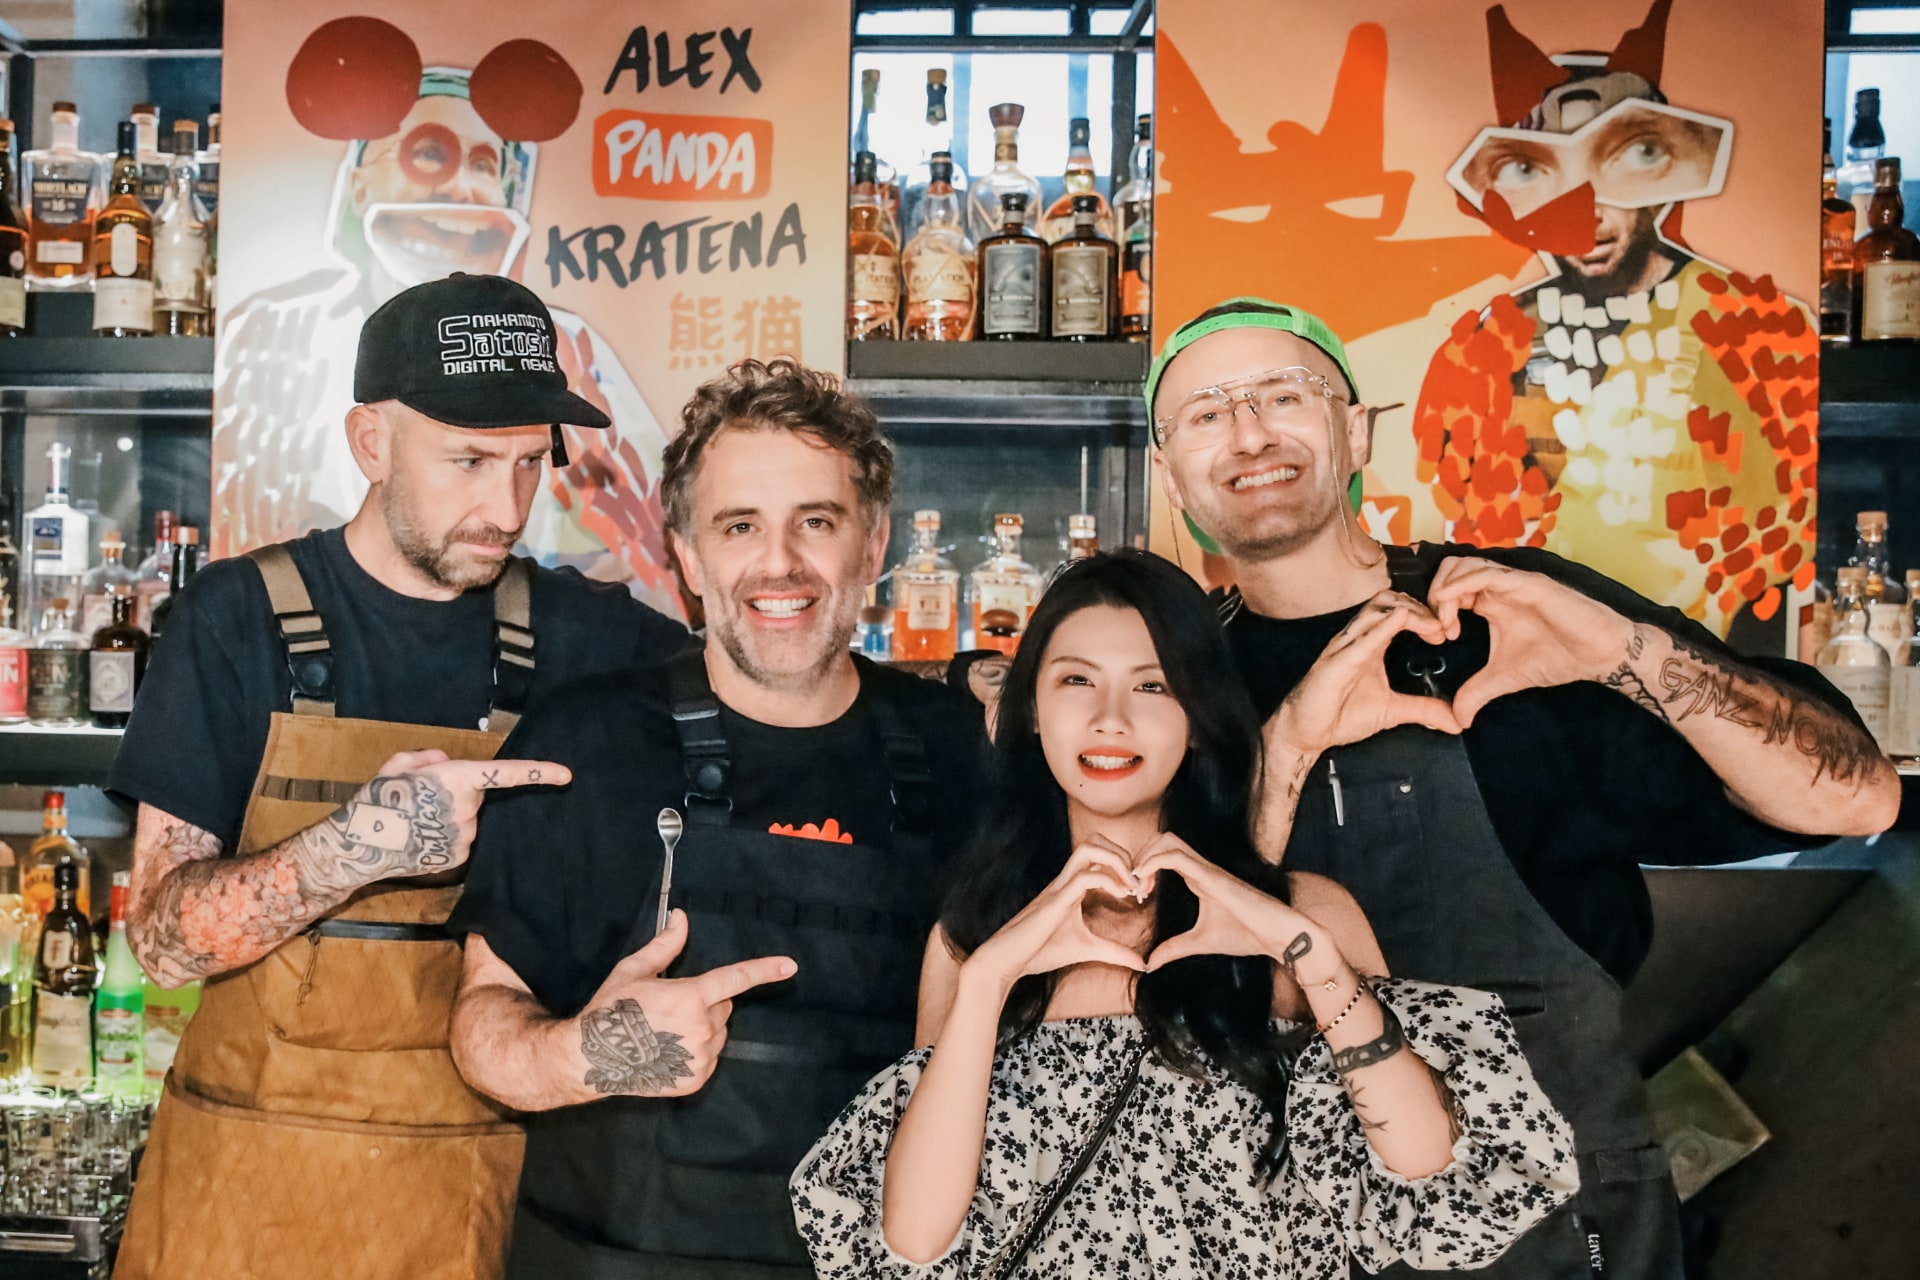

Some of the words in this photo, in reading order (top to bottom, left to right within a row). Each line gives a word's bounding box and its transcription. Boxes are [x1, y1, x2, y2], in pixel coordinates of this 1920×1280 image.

[604, 25, 762, 95] ALEX
[605, 120, 757, 195] PANDA
[545, 202, 807, 289] KRATENA
[443, 359, 515, 376] DIGITAL
[668, 290, 803, 371] 熊猫
[1658, 658, 1763, 728] GANZ
[413, 780, 450, 866] Outlaw
